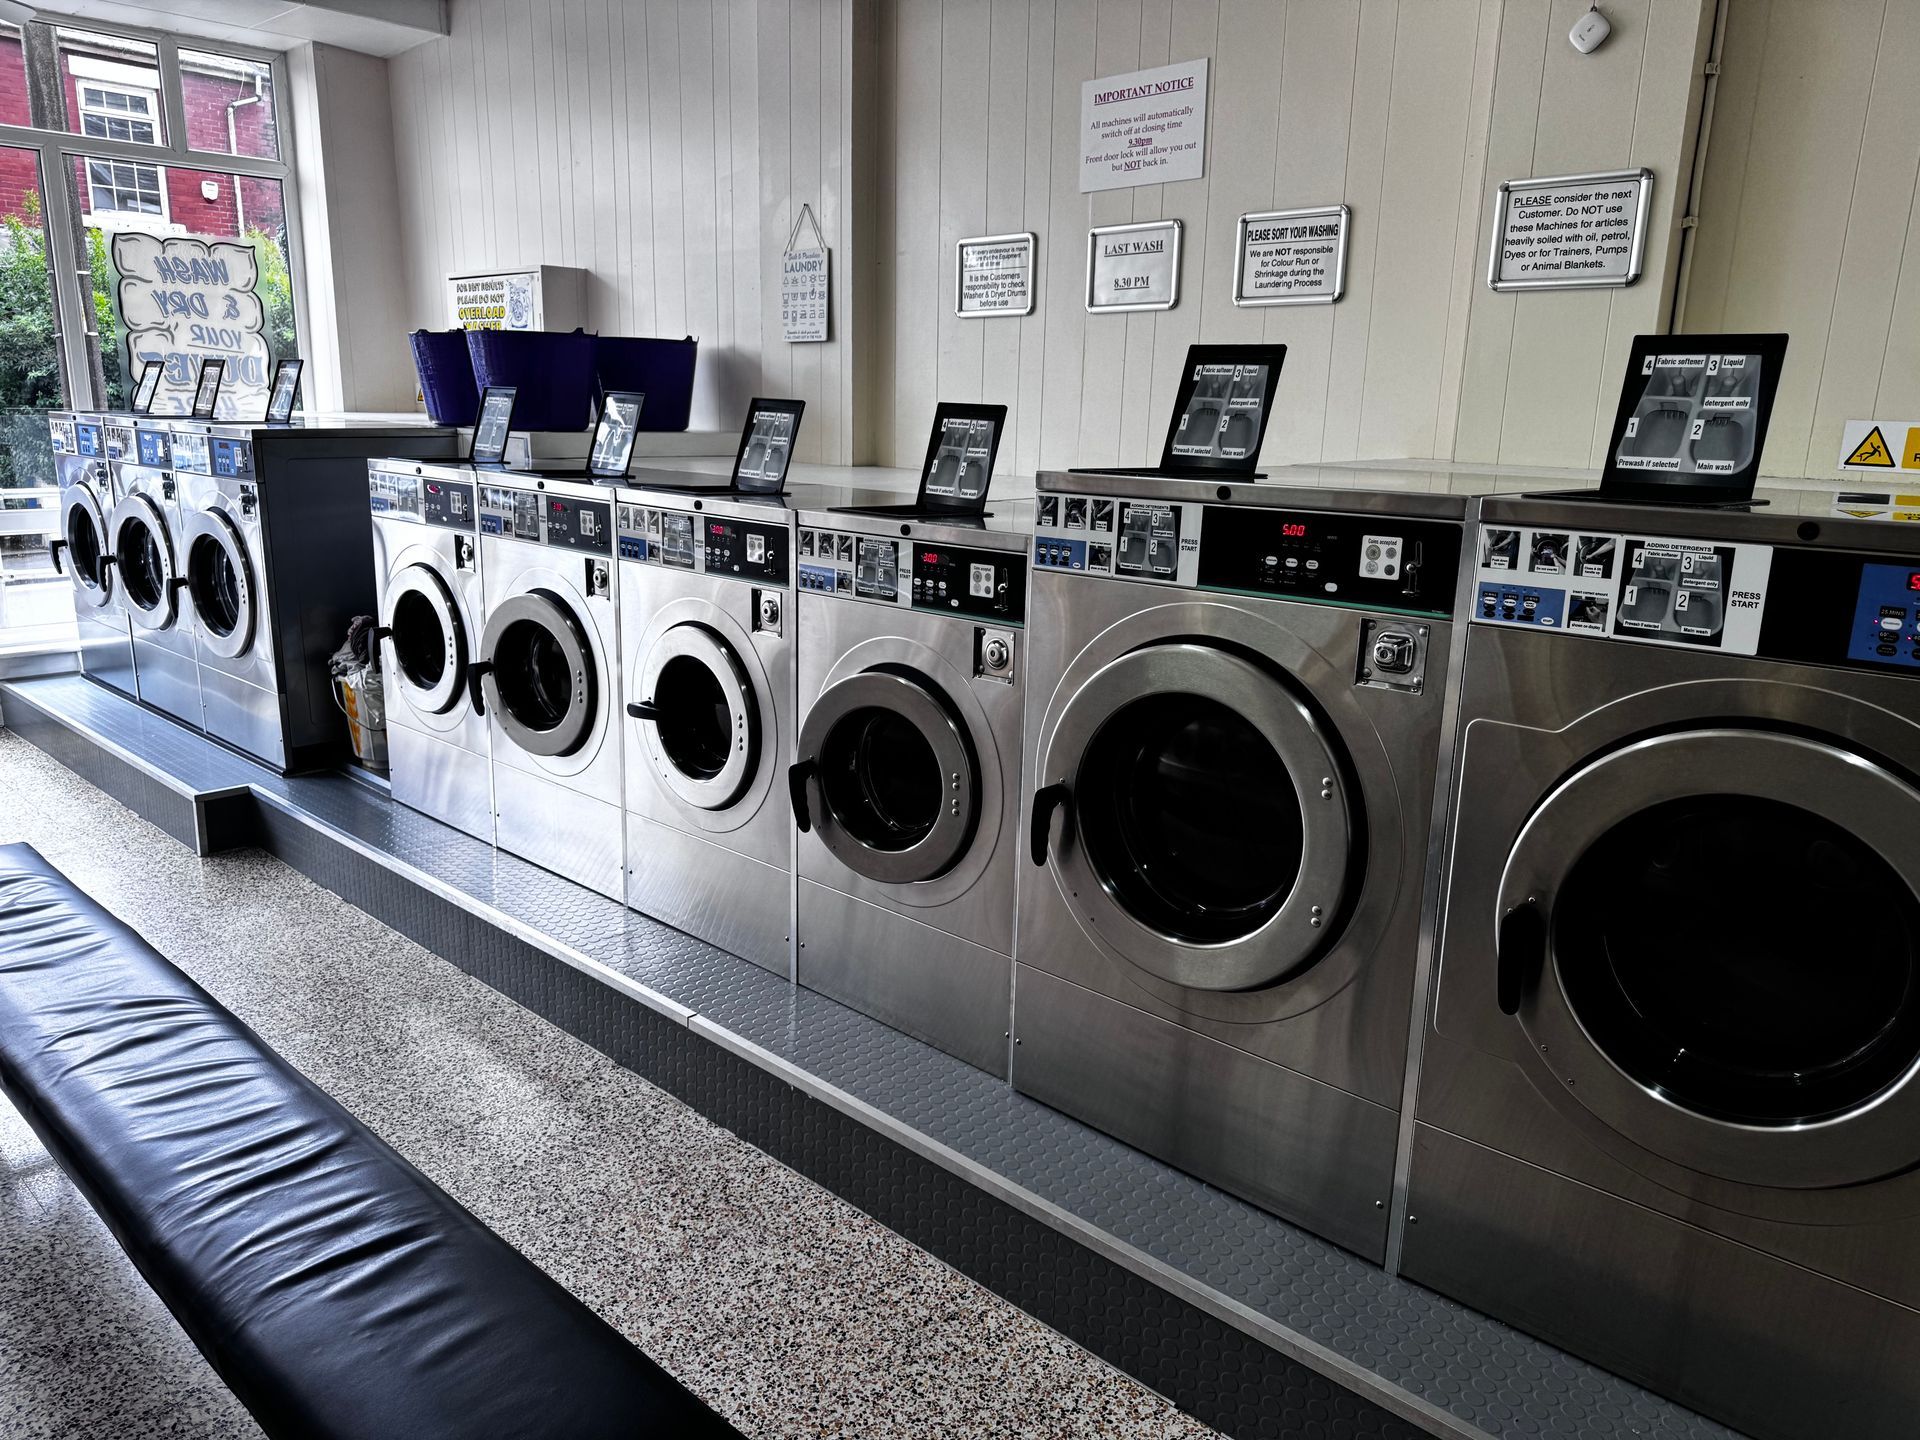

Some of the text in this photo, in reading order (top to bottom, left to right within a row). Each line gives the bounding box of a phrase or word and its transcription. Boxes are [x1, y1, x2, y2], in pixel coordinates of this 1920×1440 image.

[1094, 77, 1194, 104] IMPORTANT NOTICE
[1091, 106, 1193, 130] All machines will automatically
[1101, 129, 1122, 139] switch
[1124, 127, 1132, 136] off
[1142, 123, 1165, 133] closing
[1167, 121, 1182, 129] time
[1128, 137, 1152, 148] 9.30pm
[1085, 142, 1196, 164] Front door lock will allow you out
[1112, 163, 1122, 171] but
[1124, 160, 1141, 170] NOT
[1143, 158, 1158, 168] back
[1514, 190, 1632, 207] PLEASE consider the next
[1519, 210, 1563, 219] Customer.
[1566, 208, 1578, 216] Do
[1581, 205, 1603, 214] NOT
[1510, 218, 1628, 233] these Machines for articles
[1248, 224, 1338, 241] PLEASE SORT YOUR WASHING
[1505, 231, 1630, 246] heavily soiled with oil, petrol,
[1104, 240, 1163, 255] LAST WASH
[1275, 248, 1291, 256] NOT
[1293, 246, 1333, 255] responsible
[1505, 250, 1525, 260] Dyes
[1540, 249, 1551, 257] for
[1553, 247, 1592, 257] Trainers,
[1596, 246, 1628, 255] Pumps
[785, 260, 823, 273] LAUNDRY
[1271, 259, 1293, 267] Colour
[1532, 261, 1561, 270] Animal
[1564, 260, 1605, 269] Blankets.
[1255, 270, 1288, 279] Shrinkage
[1290, 269, 1311, 277] during
[457, 280, 503, 292] FOR BEST RESULTS
[965, 283, 999, 291] responsibility
[1114, 276, 1149, 289] 8.30 PM
[1255, 279, 1322, 289] Laundering Process
[457, 293, 504, 305] PLEASE DO NOT
[991, 291, 1005, 299] Dryer
[459, 306, 505, 320] OVERLOAD
[1646, 361, 1652, 370] 4
[1710, 361, 1717, 371] 3
[1724, 359, 1743, 367] Liquid
[1236, 369, 1241, 377] 3
[1705, 400, 1734, 408] detergent
[1222, 420, 1227, 428] 2
[1631, 423, 1634, 432] 1
[1693, 425, 1701, 435] 2
[1125, 511, 1130, 519] 4
[1153, 514, 1158, 524] 3
[1123, 540, 1126, 548] 1
[1151, 543, 1156, 552] 2
[1671, 544, 1712, 552] DETERGENTS
[1635, 553, 1642, 565] 4
[1684, 557, 1692, 569] 3
[879, 571, 883, 579] 2
[1629, 590, 1634, 601] 1
[1732, 591, 1760, 600] PRESS
[1678, 595, 1687, 607] 2
[1732, 600, 1759, 609] START
